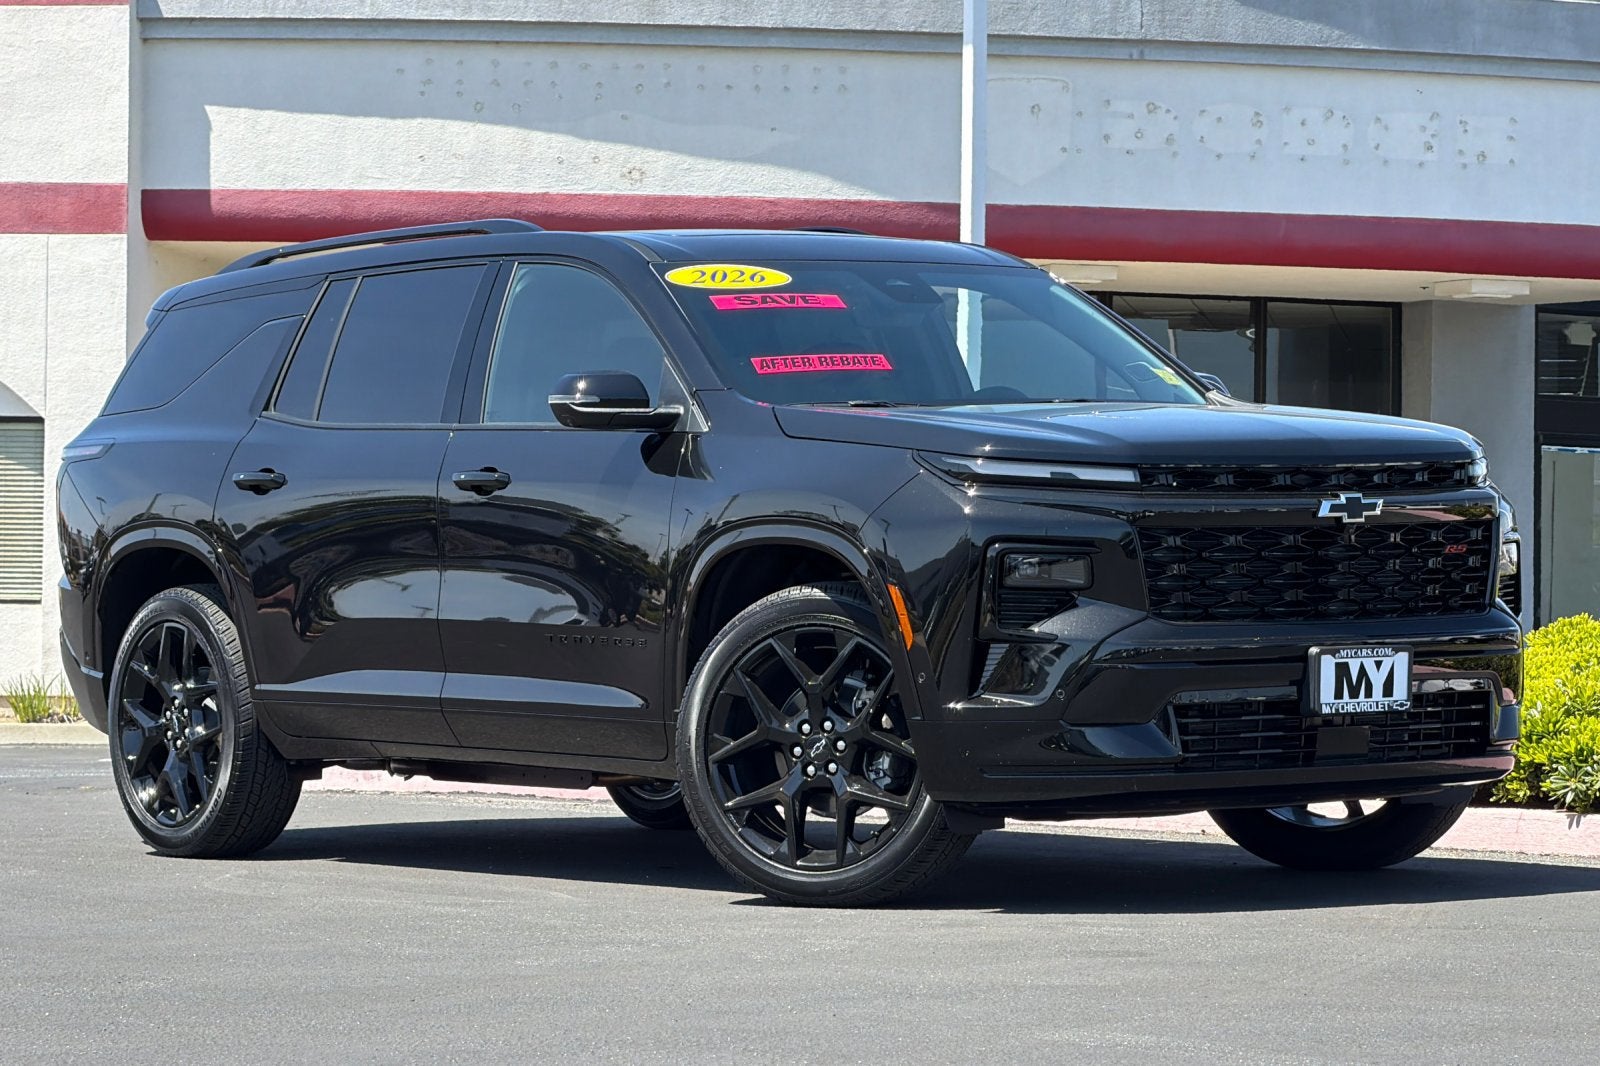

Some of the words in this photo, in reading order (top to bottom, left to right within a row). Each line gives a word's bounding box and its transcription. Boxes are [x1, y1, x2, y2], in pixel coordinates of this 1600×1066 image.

[690, 269, 766, 284] 2026
[733, 295, 821, 306] SAVE
[759, 357, 813, 370] AFTER
[819, 355, 882, 368] REBATE
[1444, 544, 1468, 554] RS
[544, 633, 649, 648] TRAVERSE
[1334, 659, 1395, 701] MY
[1321, 703, 1336, 715] MY
[1339, 701, 1390, 714] CHEVROLET
